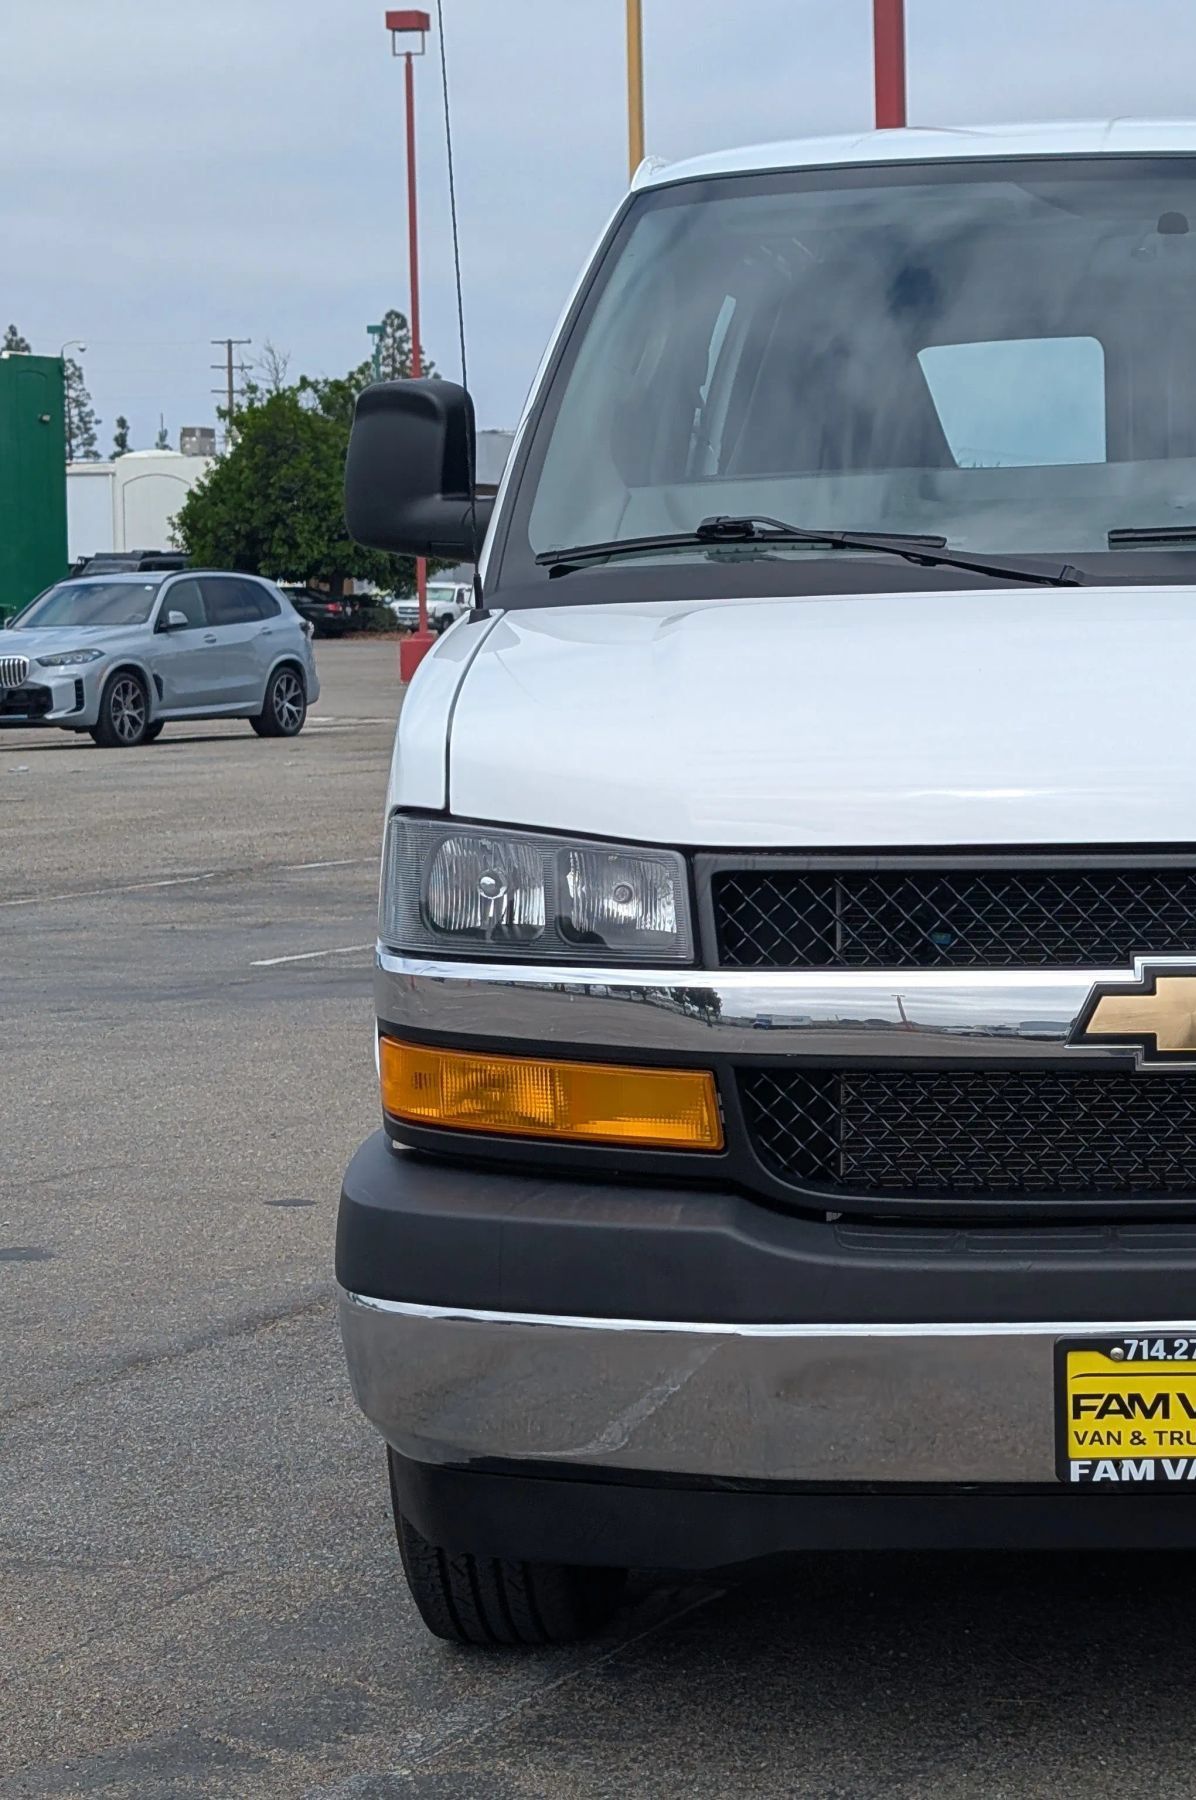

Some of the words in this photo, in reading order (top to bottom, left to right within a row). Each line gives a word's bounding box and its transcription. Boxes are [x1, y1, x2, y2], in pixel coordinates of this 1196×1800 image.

[1072, 1392, 1171, 1420] FAM
[1073, 1430, 1122, 1446] VAN
[1129, 1430, 1147, 1446] &
[1070, 1459, 1155, 1482] FAM
